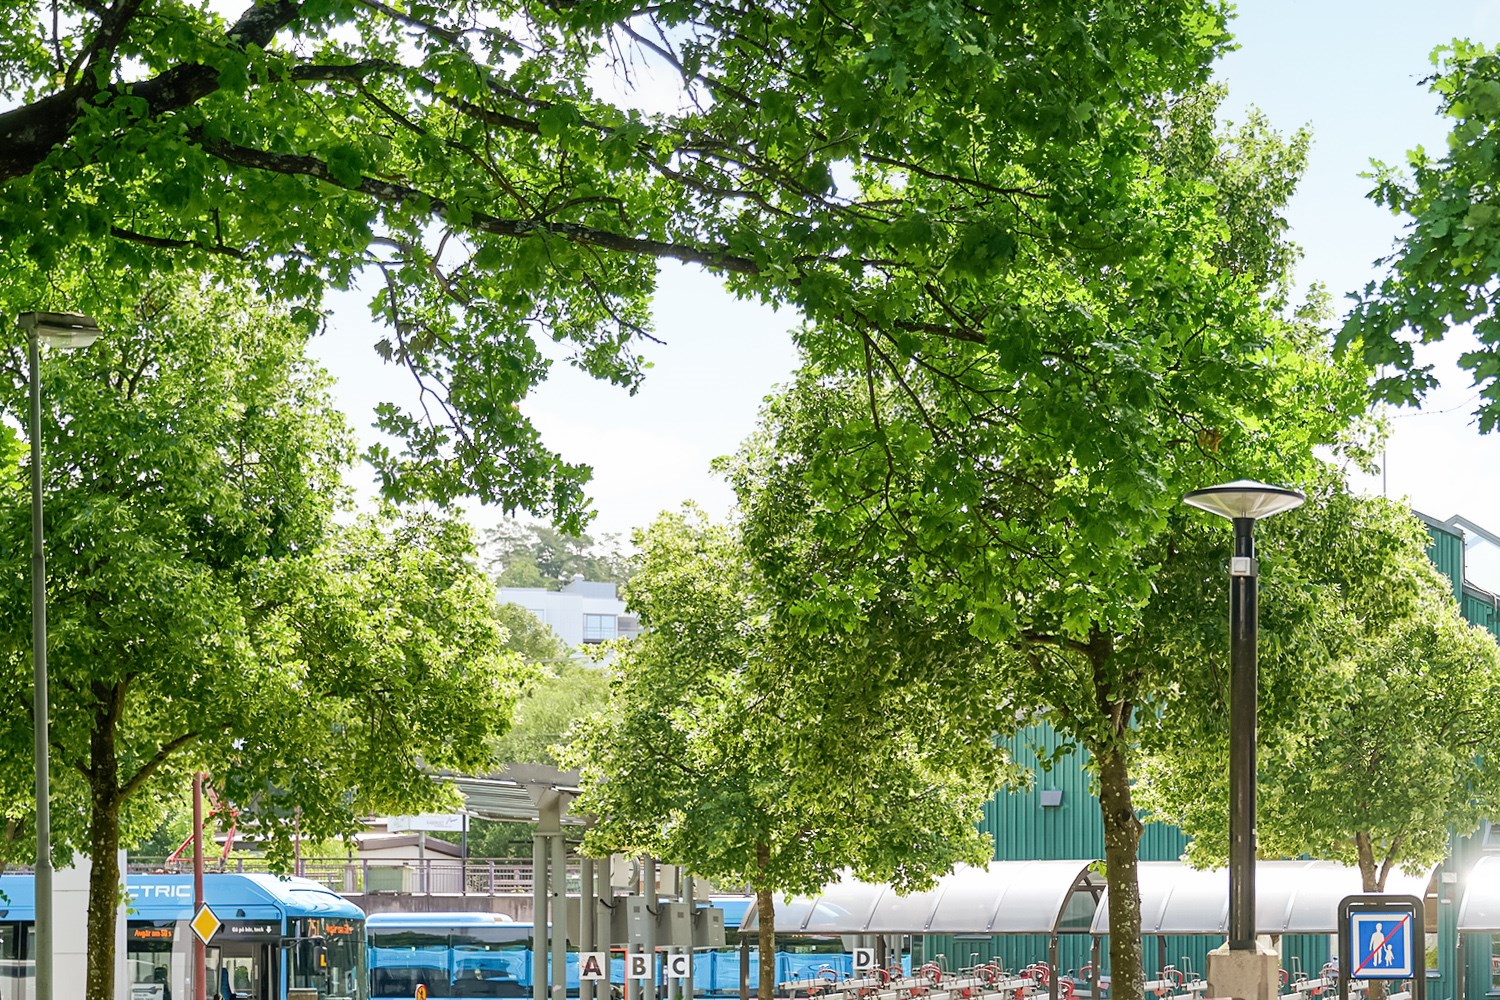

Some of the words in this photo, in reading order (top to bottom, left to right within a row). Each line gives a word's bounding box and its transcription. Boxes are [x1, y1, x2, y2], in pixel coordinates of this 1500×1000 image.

[582, 955, 602, 976] A
[632, 957, 647, 976] B
[672, 957, 685, 975] C
[857, 951, 870, 966] D
